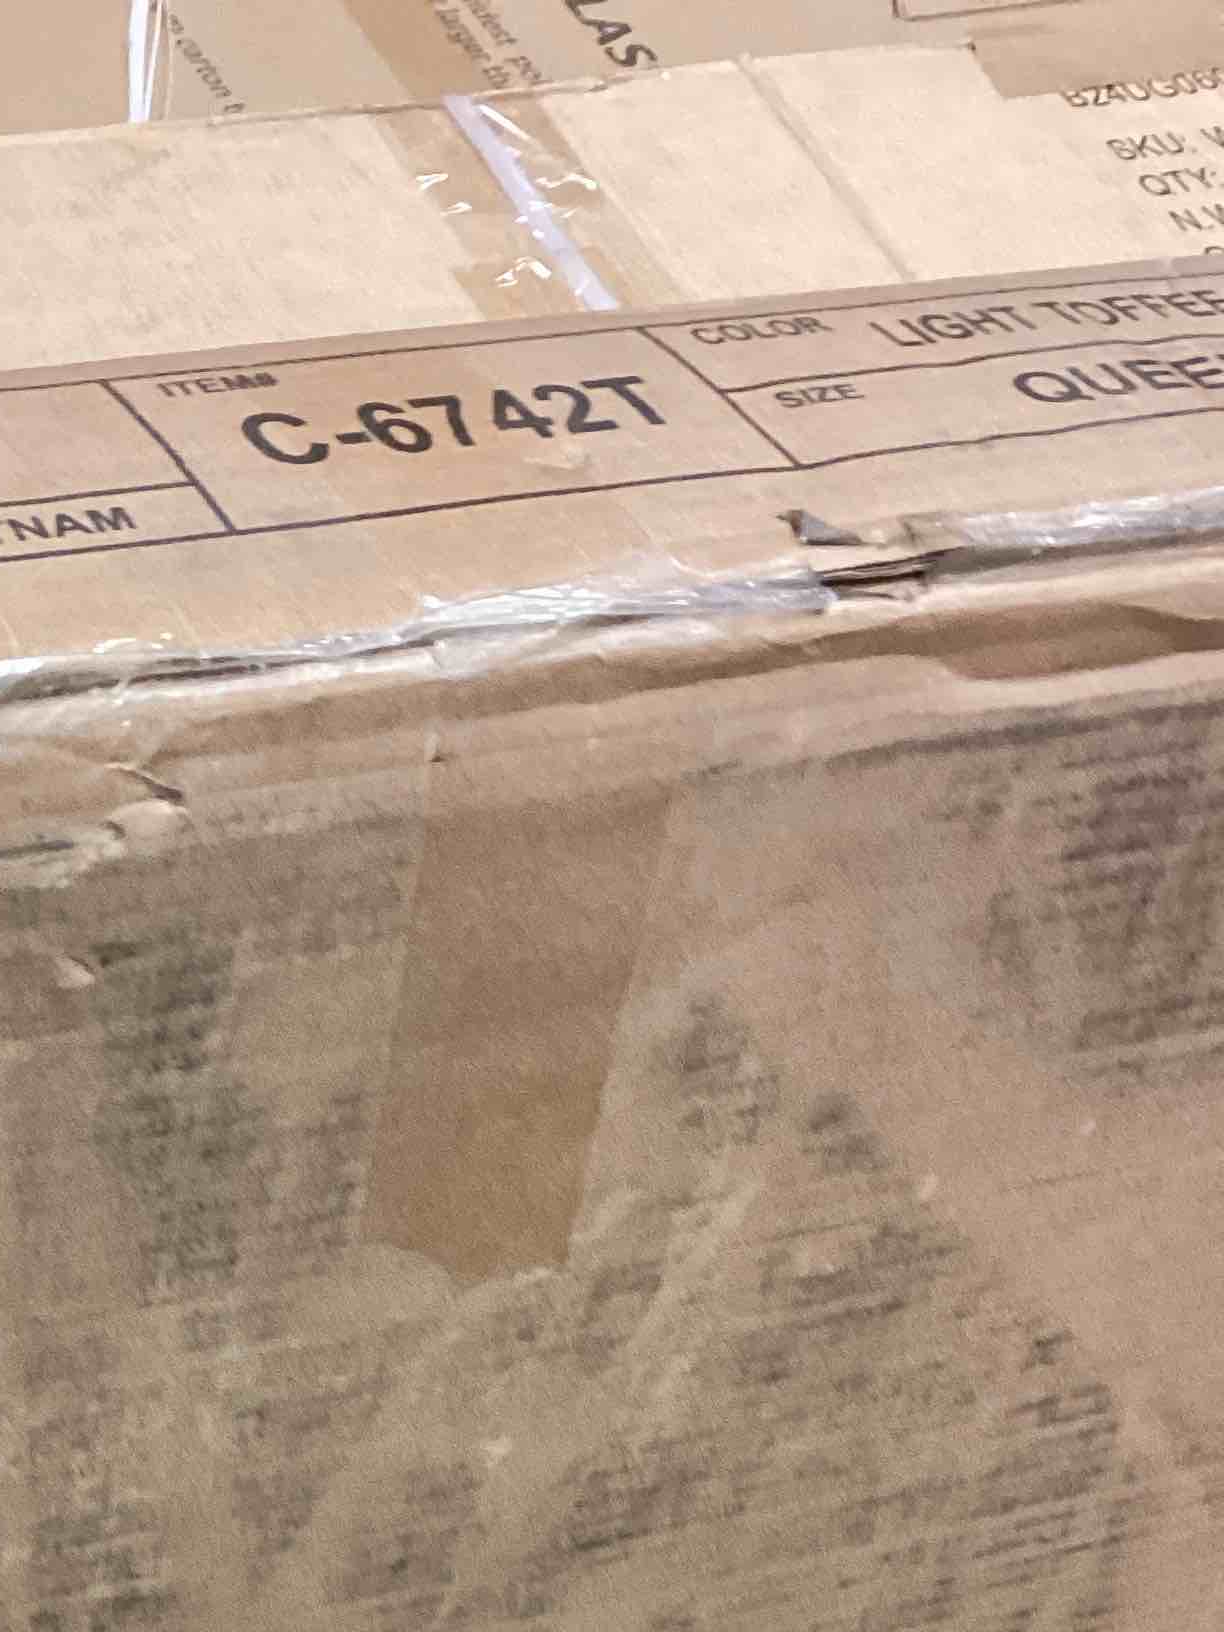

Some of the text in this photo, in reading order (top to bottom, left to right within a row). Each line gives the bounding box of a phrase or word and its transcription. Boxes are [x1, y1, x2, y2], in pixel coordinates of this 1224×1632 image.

[690, 290, 1224, 348] COLOR LIGHT TOFFEE
[157, 371, 280, 398] ITEM#
[775, 354, 1224, 409] SIZE QUEE
[240, 374, 667, 465] C-6742T
